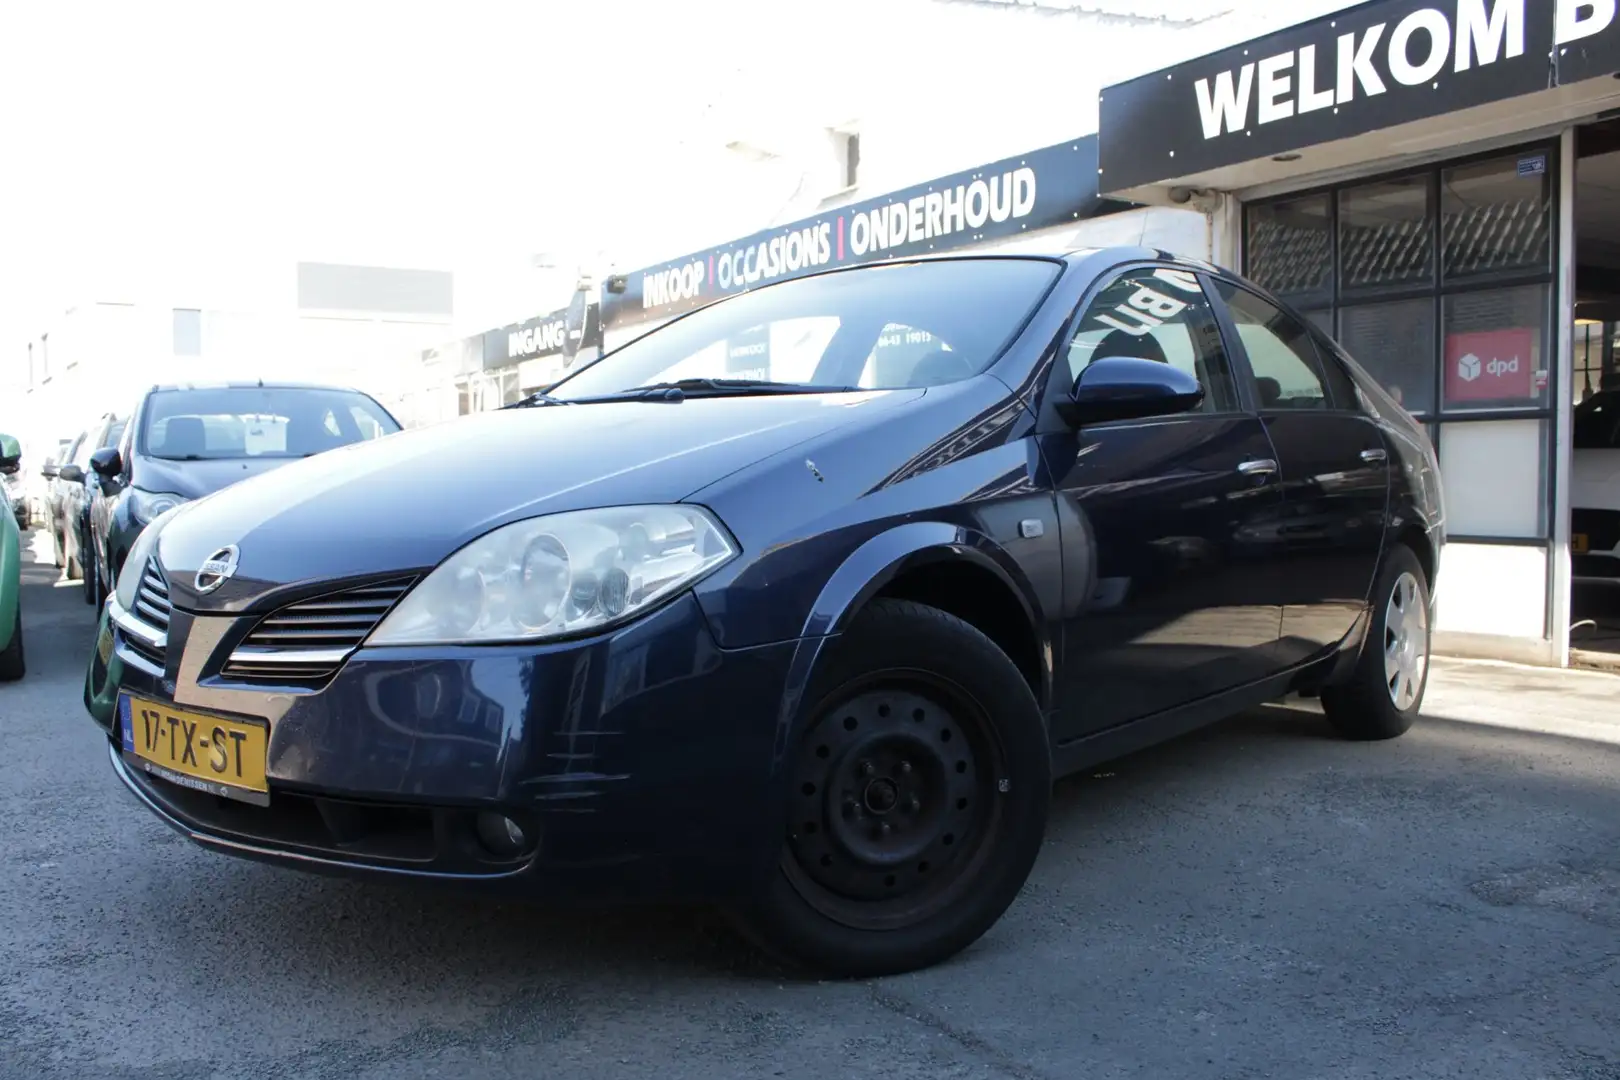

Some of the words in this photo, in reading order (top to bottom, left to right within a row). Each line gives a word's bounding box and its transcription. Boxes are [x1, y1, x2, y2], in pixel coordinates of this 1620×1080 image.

[1194, 0, 1524, 139] WELKOM
[643, 261, 705, 308] INKOOP
[718, 222, 831, 289] OCCASIONS
[850, 167, 1036, 256] ONDERHOUD
[508, 320, 565, 357] INGANG
[1486, 355, 1519, 377] dpd
[141, 709, 247, 778] 17-TX-ST
